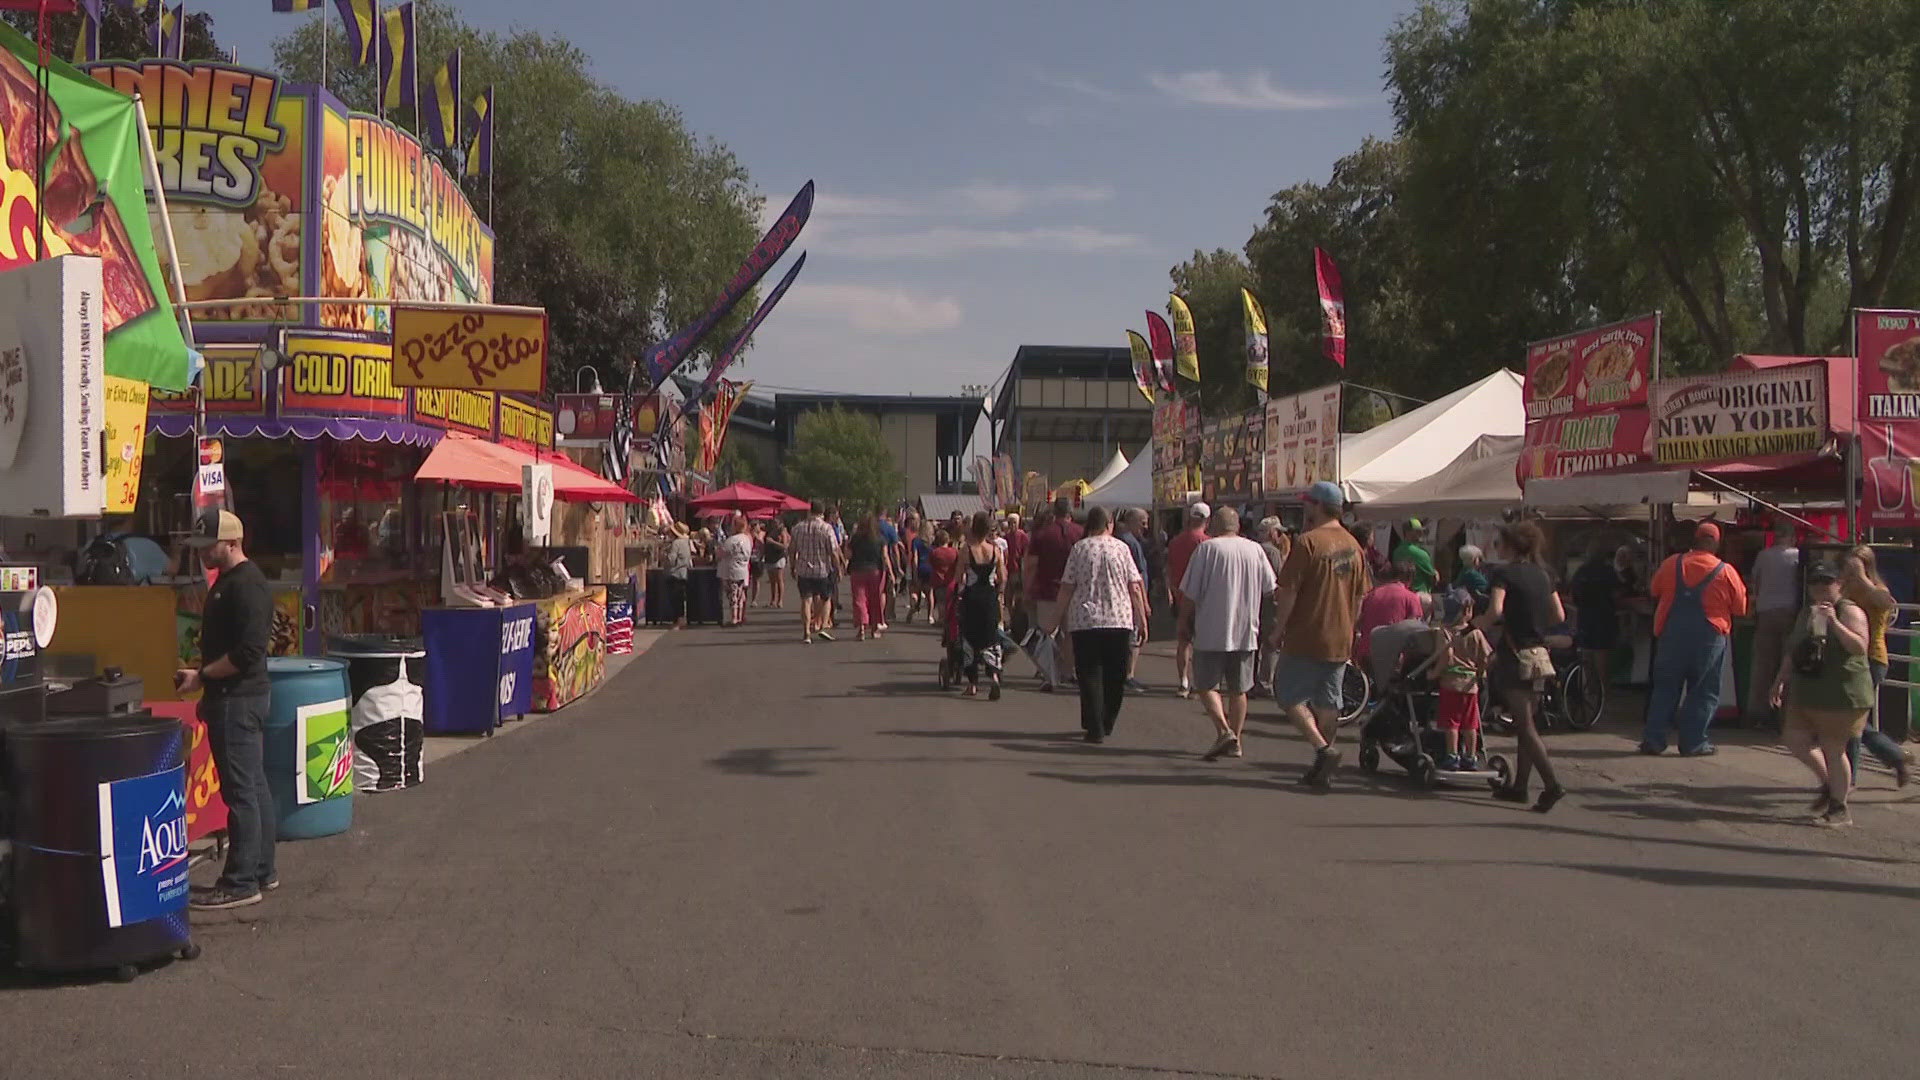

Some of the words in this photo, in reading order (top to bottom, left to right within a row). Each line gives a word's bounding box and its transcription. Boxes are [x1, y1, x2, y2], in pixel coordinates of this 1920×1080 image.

[348, 118, 425, 236] FUNNEL
[431, 160, 482, 295] CAKES
[401, 312, 484, 380] Pizza
[462, 332, 540, 386] Rita
[294, 353, 347, 396] COLD
[1718, 379, 1816, 410] ORIGINAL
[1559, 413, 1620, 451] FROZEN
[1658, 413, 1717, 438] NEW
[1730, 406, 1817, 432] YORK
[1658, 438, 1699, 461] ITALIAN
[1702, 436, 1751, 459] SAUSAGE
[1754, 431, 1816, 454] SANDWICH
[201, 471, 223, 487] VISA
